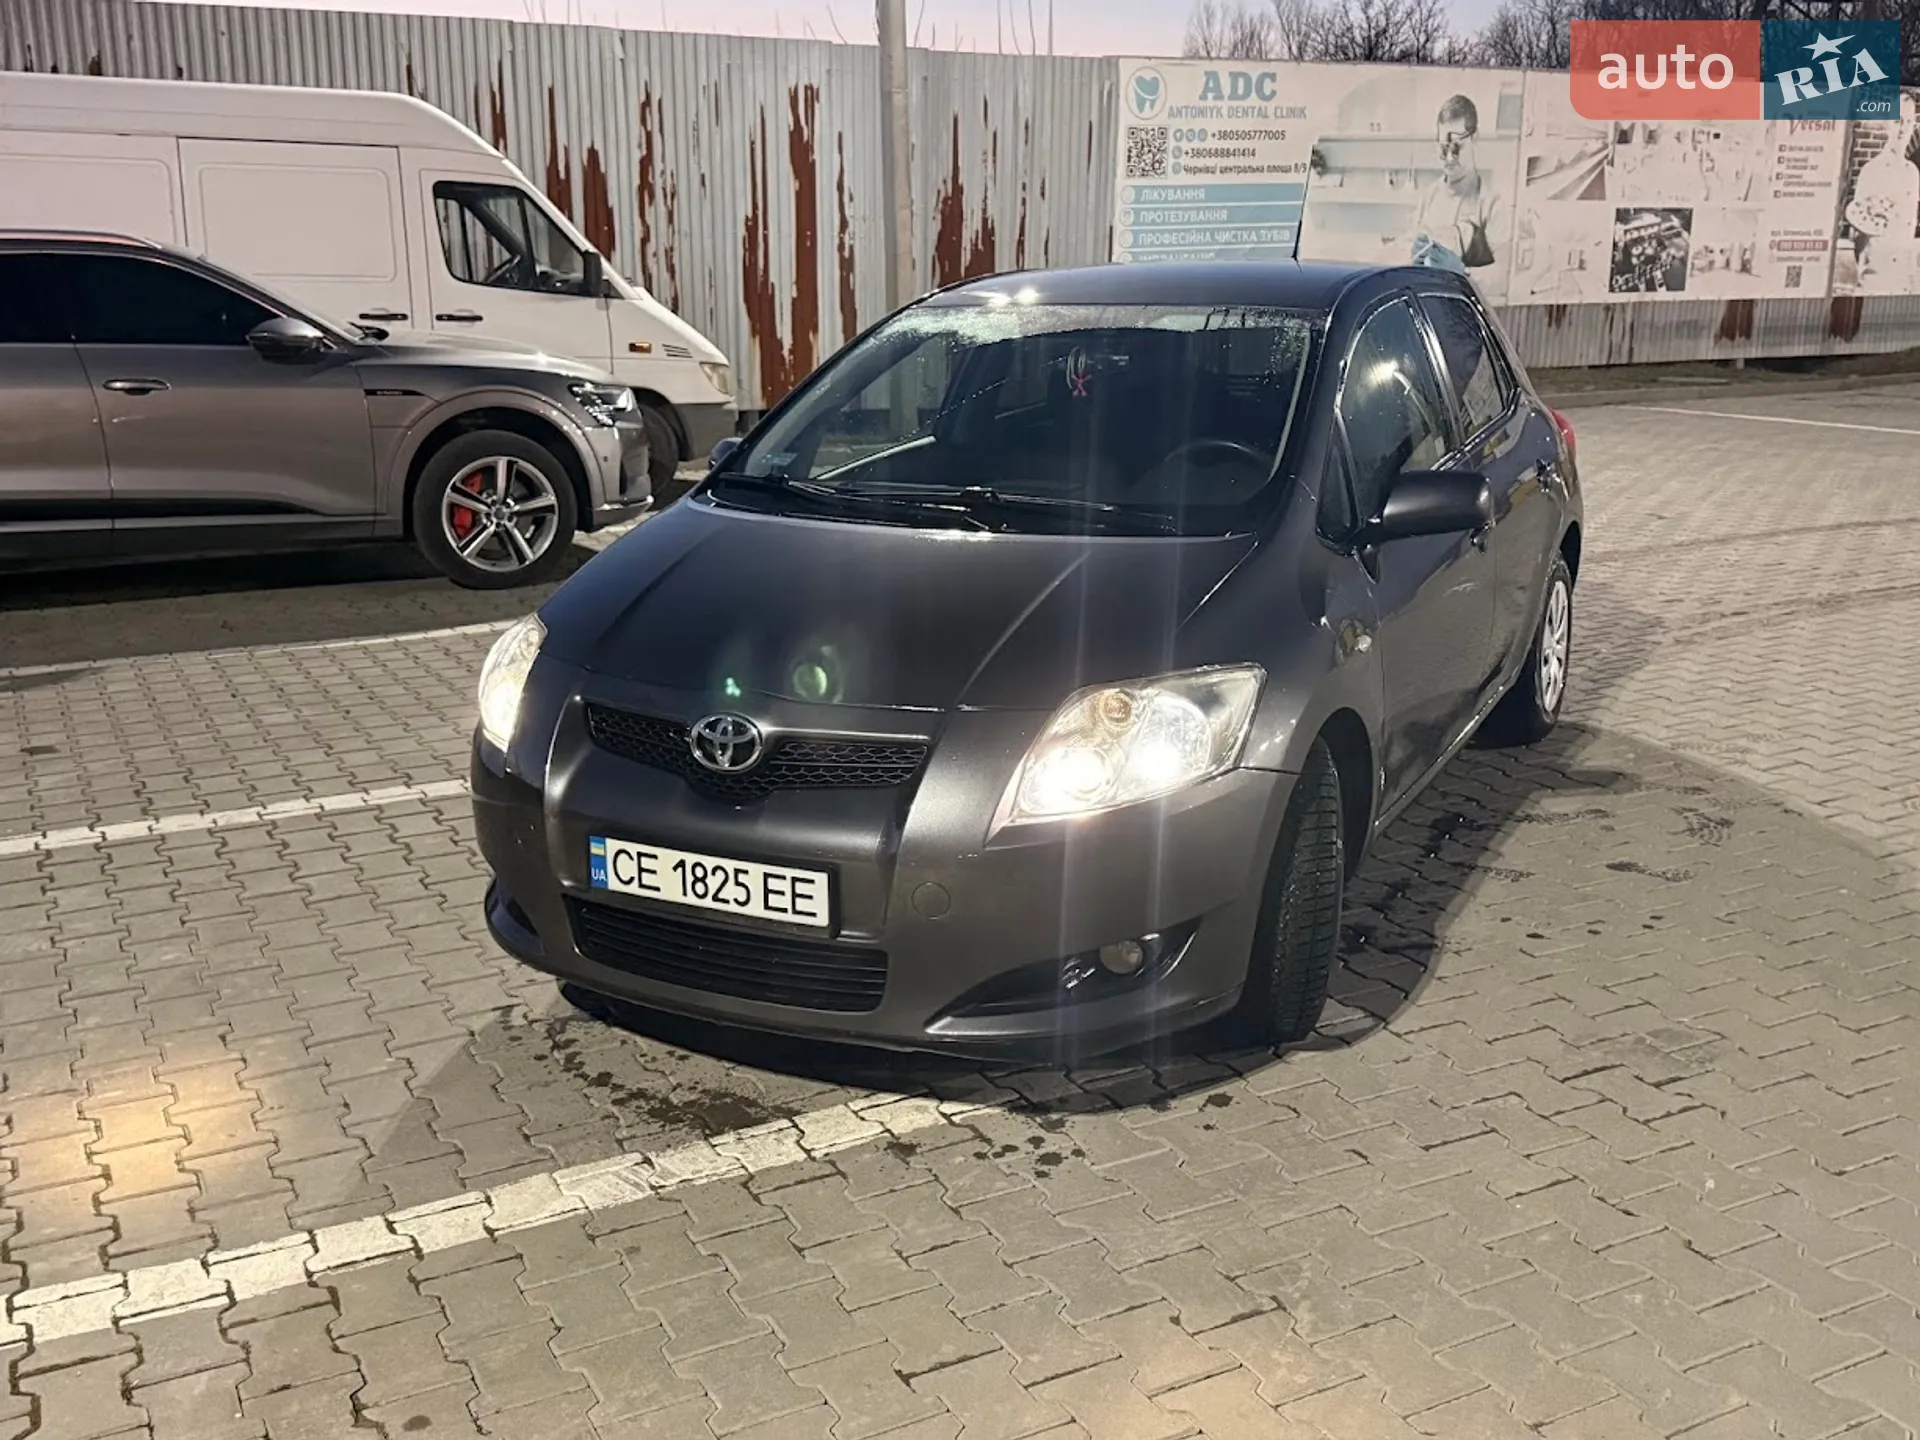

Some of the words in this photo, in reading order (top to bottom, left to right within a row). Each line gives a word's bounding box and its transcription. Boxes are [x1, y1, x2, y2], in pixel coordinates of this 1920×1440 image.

[1199, 70, 1278, 102] ADC
[1227, 106, 1269, 119] DENTAL
[1274, 106, 1307, 120] CLINIK
[1140, 188, 1205, 201] ЛІКУВАННЯ
[1139, 210, 1228, 223] ПРОТЕЗУВАННЯ
[1139, 232, 1212, 246] ПРОФЕСІЙНА
[1214, 231, 1257, 243] ЧИСТКА
[591, 868, 606, 881] UA
[612, 848, 661, 892] CE
[672, 859, 751, 907] 1825
[763, 872, 817, 917] EE
